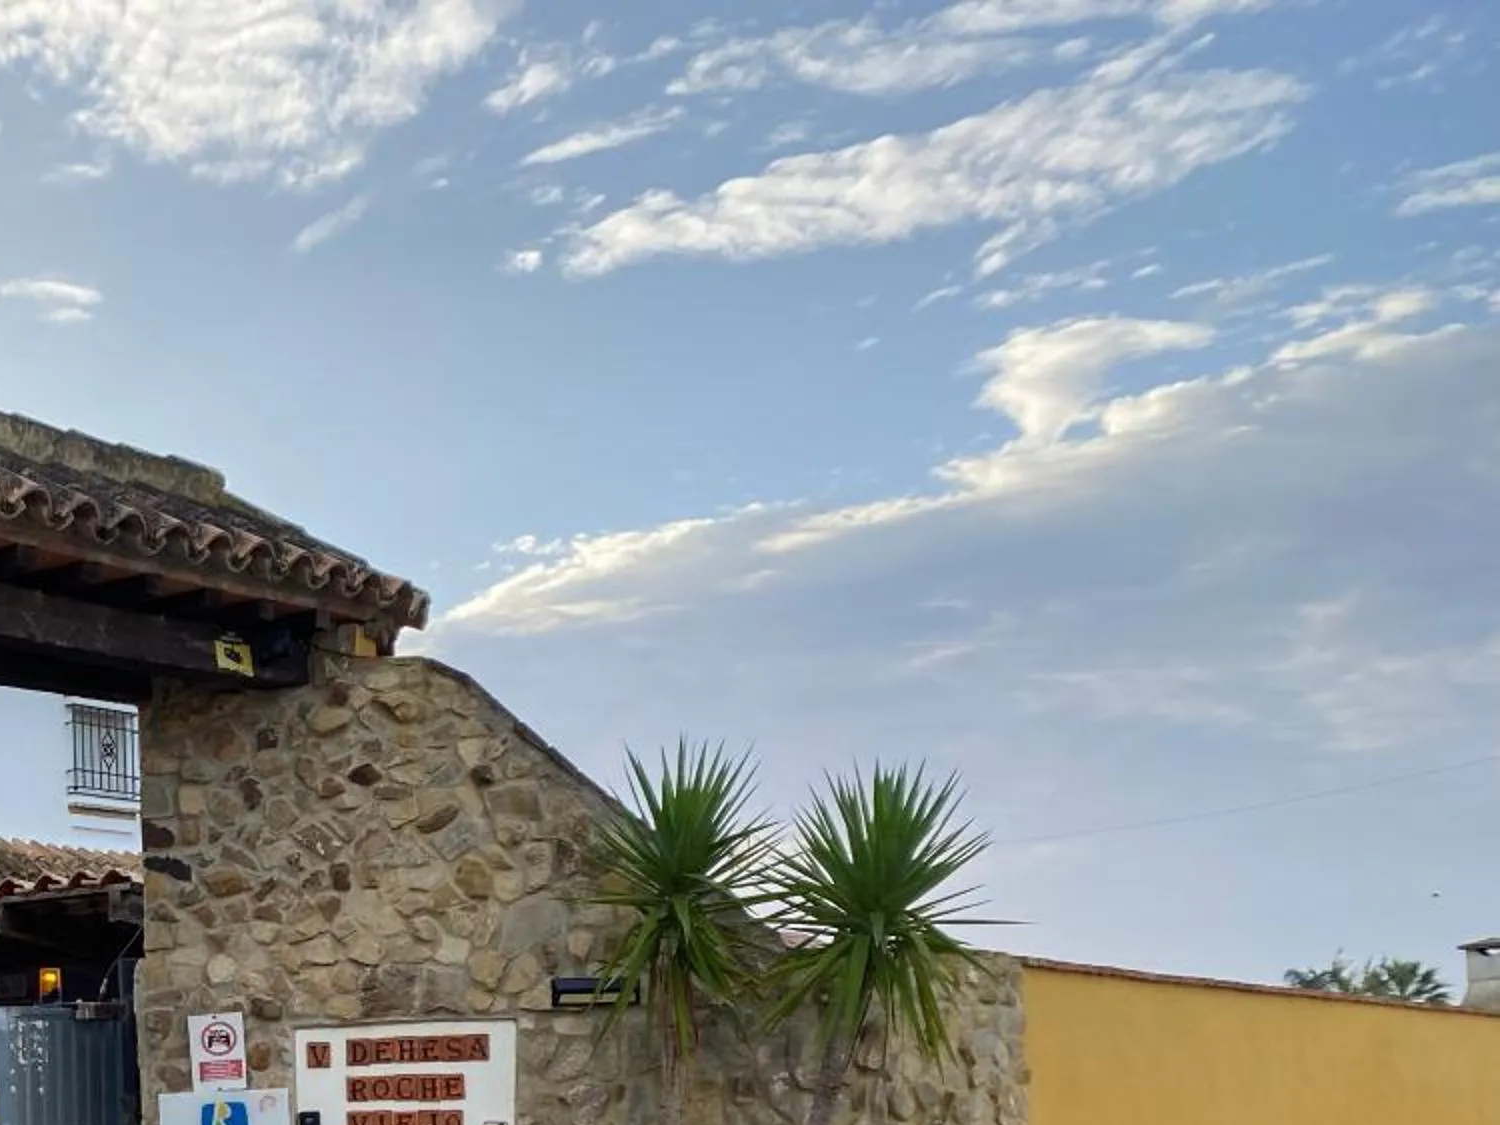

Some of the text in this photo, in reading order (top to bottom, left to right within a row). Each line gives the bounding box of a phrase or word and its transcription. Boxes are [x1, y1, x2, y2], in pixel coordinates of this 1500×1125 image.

[309, 1037, 488, 1066] V DEHESA
[351, 1077, 462, 1100] ROCHE
